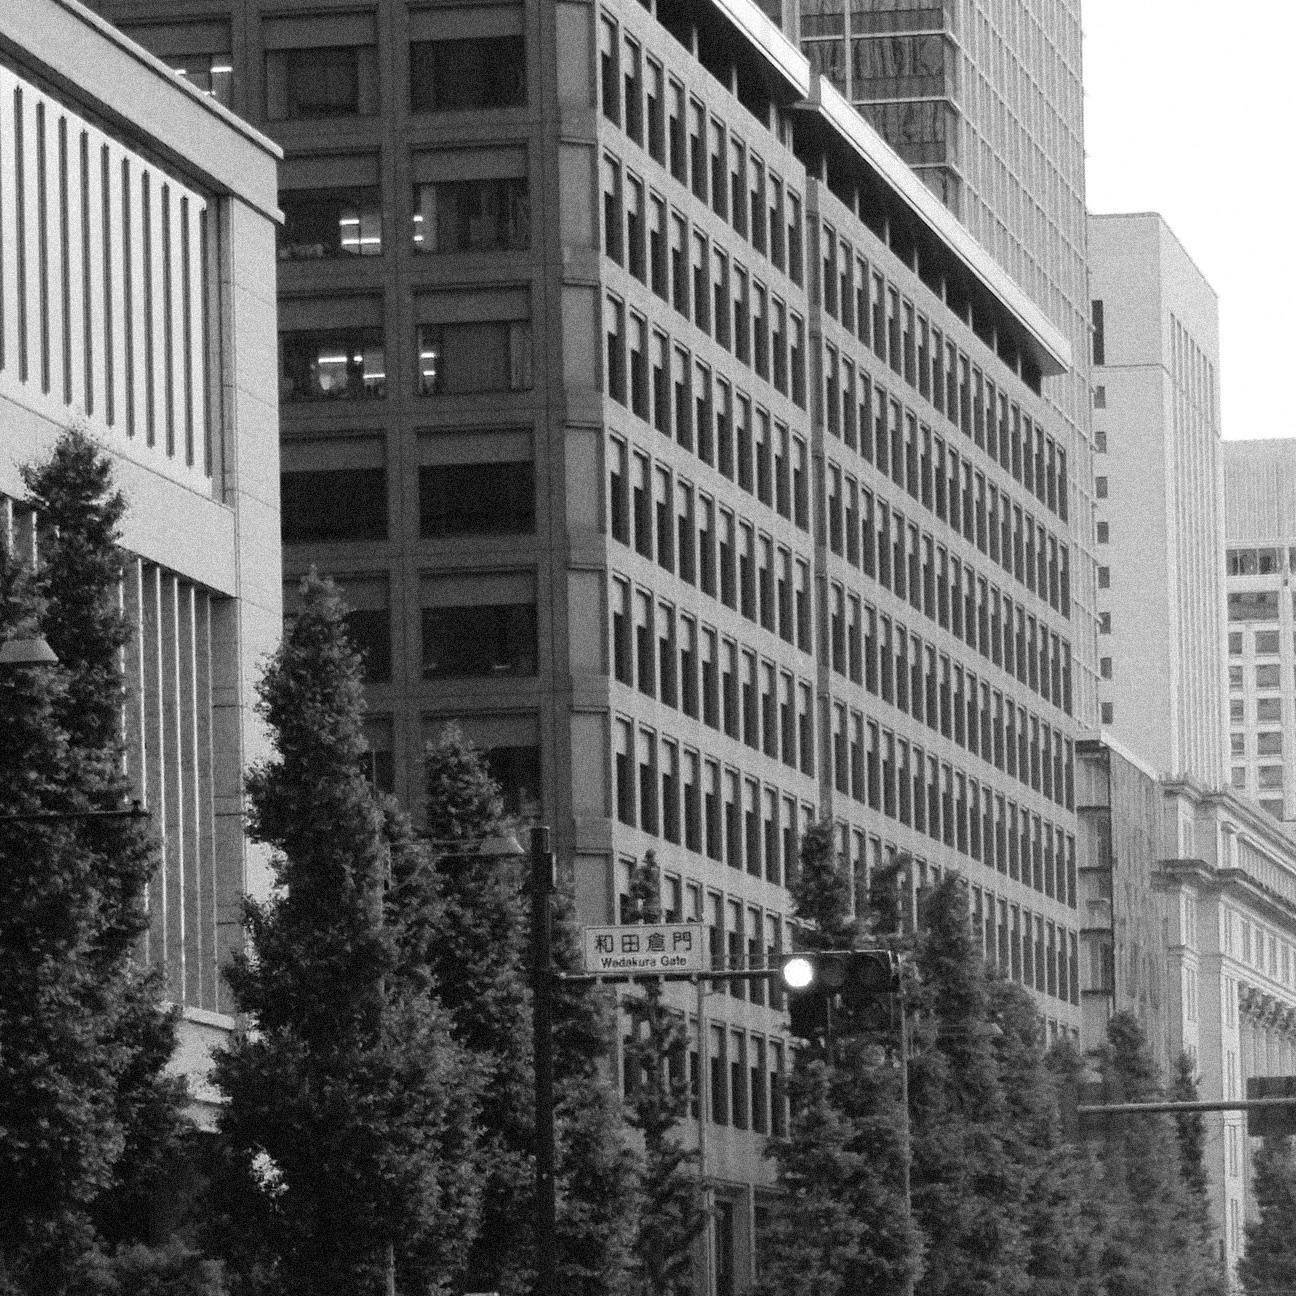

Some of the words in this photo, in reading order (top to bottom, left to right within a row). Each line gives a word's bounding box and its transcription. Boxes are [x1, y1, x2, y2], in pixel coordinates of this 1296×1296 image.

[594, 931, 692, 954] 和田倉門
[600, 956, 657, 968] Wadakura
[660, 955, 687, 967] Gate
